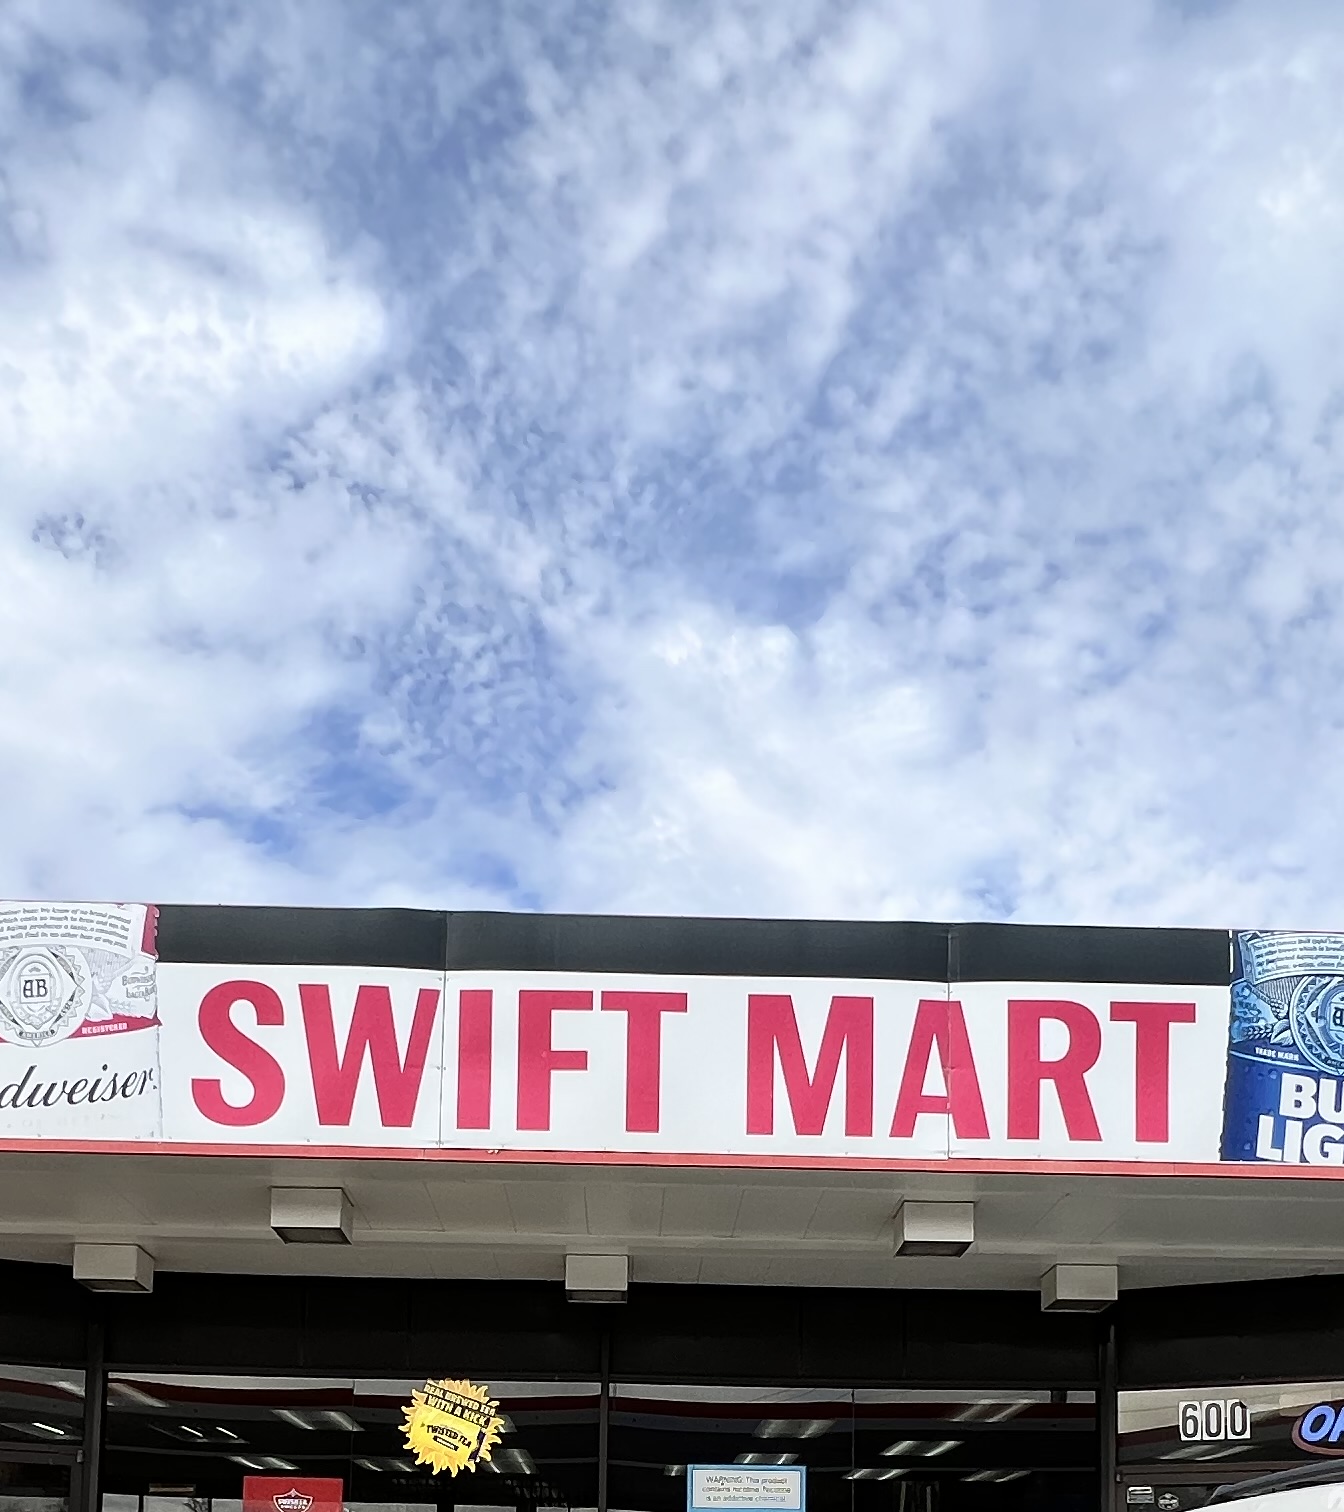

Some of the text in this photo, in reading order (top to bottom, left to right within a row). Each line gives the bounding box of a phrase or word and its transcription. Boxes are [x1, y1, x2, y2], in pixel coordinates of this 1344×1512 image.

[191, 979, 1196, 1143] SWIFT MART
[427, 1395, 454, 1414] WITH
[453, 1405, 463, 1416] A
[1182, 1401, 1249, 1439] 600
